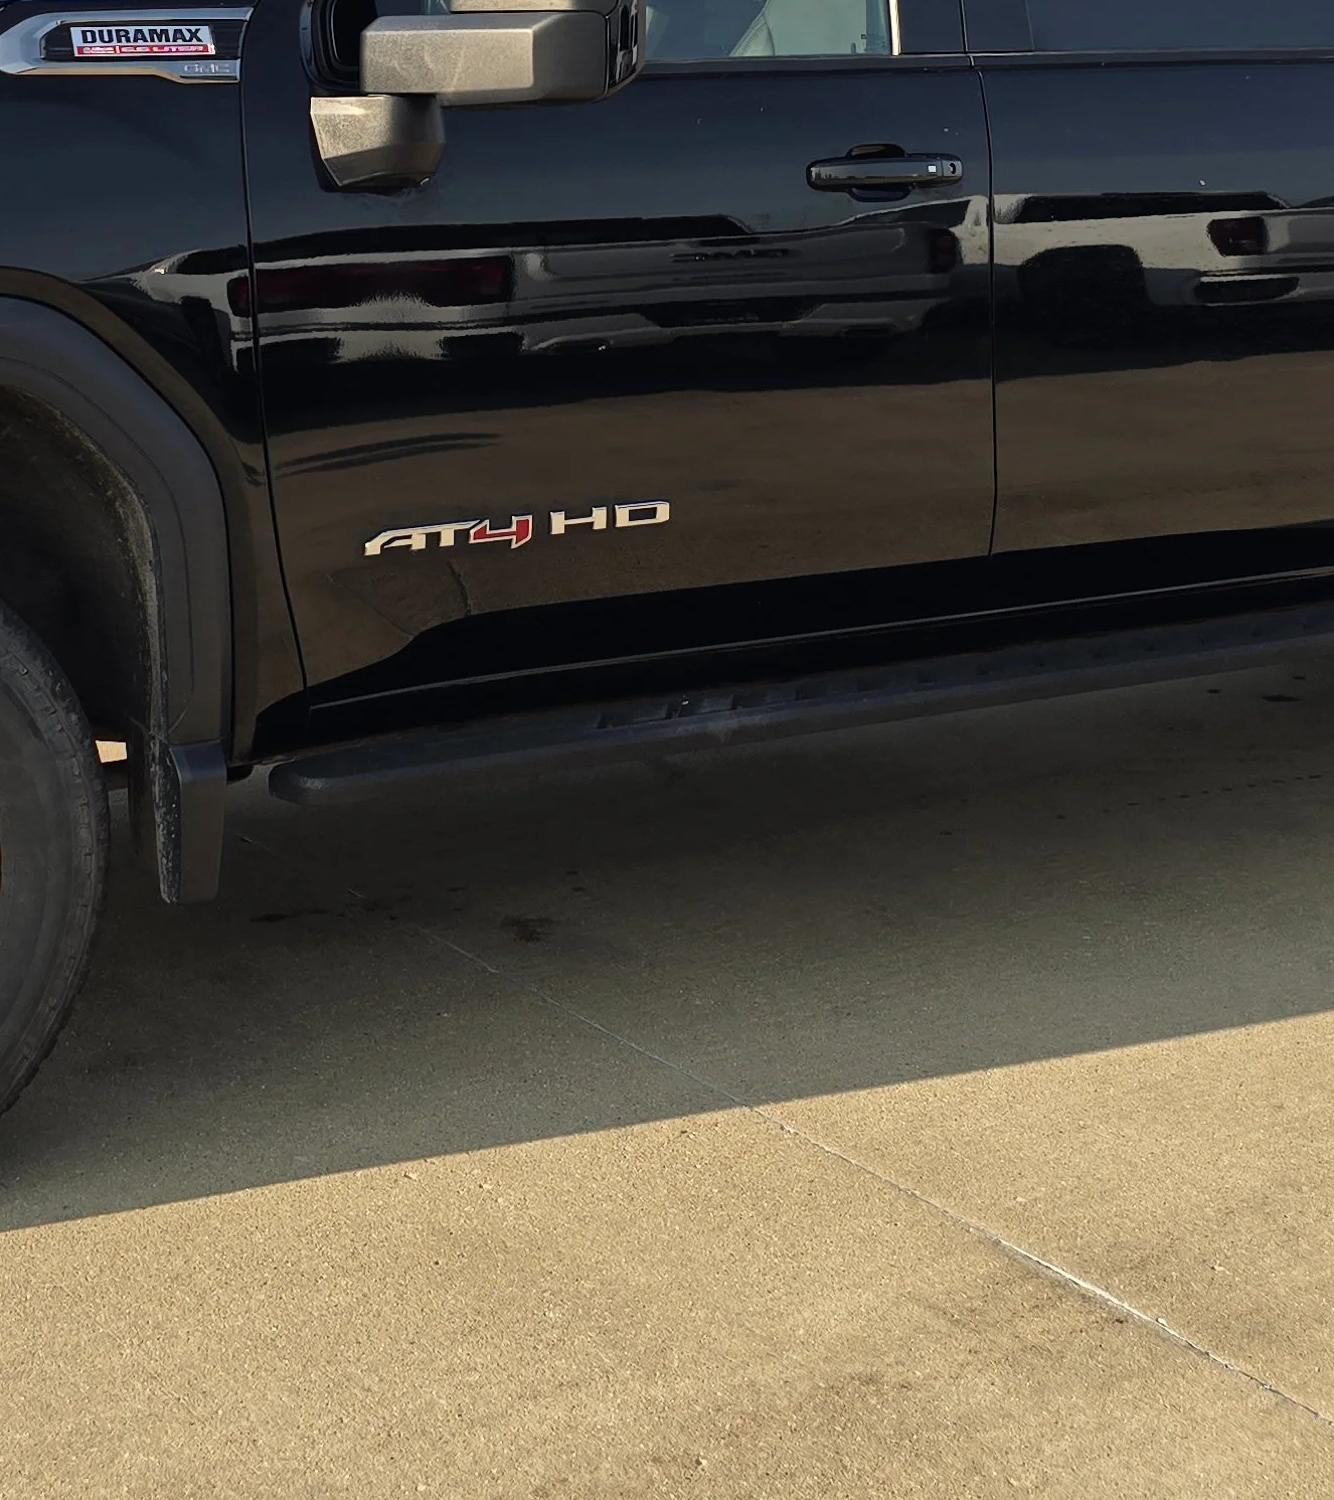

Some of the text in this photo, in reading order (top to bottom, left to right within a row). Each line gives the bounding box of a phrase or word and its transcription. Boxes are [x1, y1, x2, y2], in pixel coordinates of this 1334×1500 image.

[80, 27, 204, 44] DURAMAX
[364, 501, 670, 557] AT4 HD
